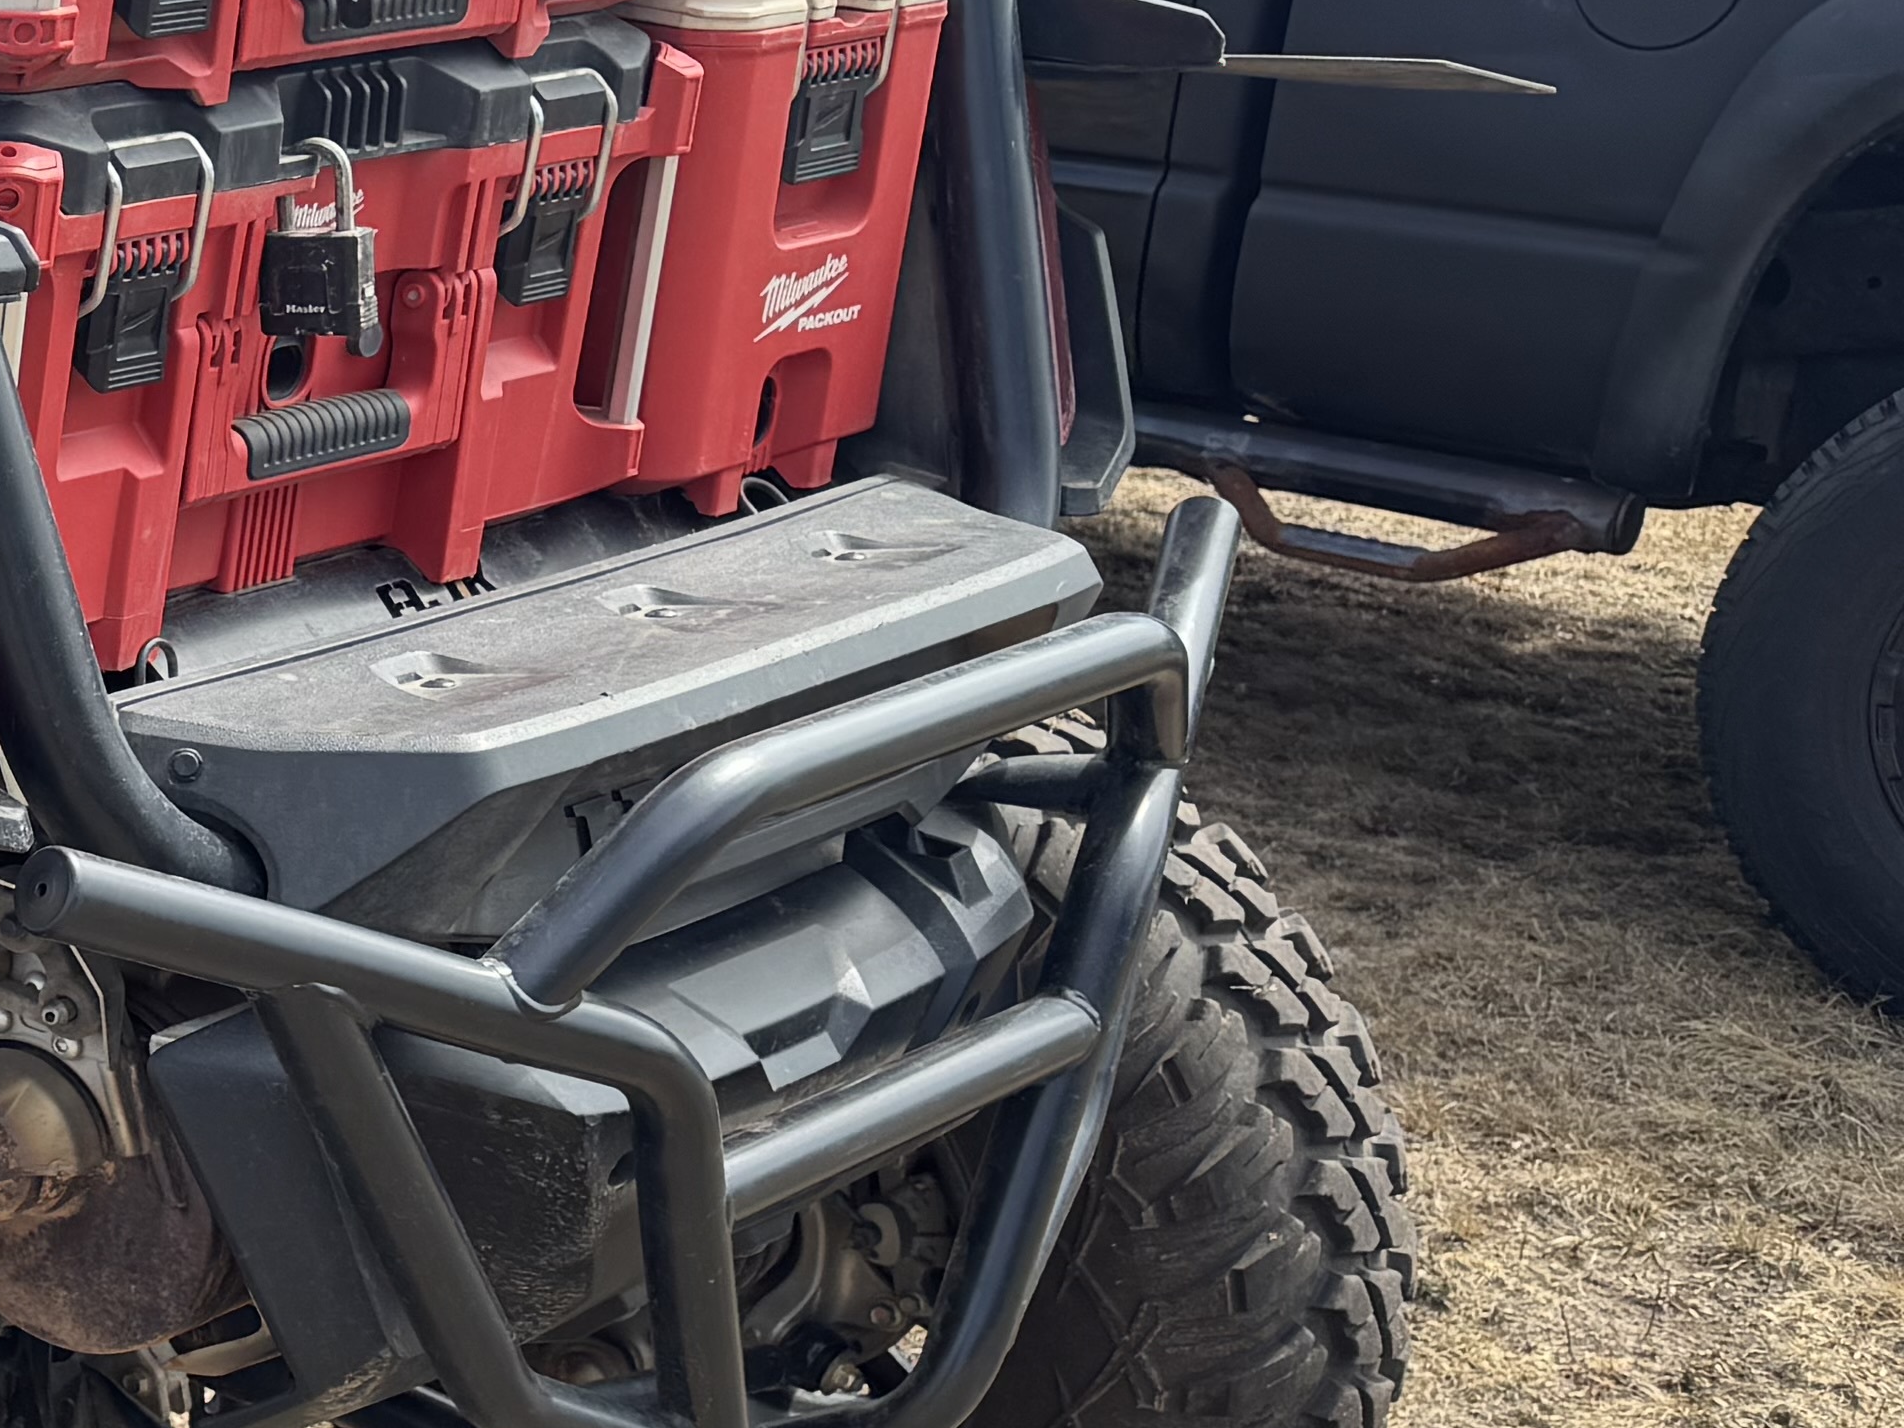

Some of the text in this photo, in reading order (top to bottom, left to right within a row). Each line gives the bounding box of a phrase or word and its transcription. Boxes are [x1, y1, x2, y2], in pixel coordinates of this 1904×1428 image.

[293, 189, 364, 227] Milwae
[759, 253, 849, 324] Milwaukee
[797, 304, 862, 333] PACKOUT
